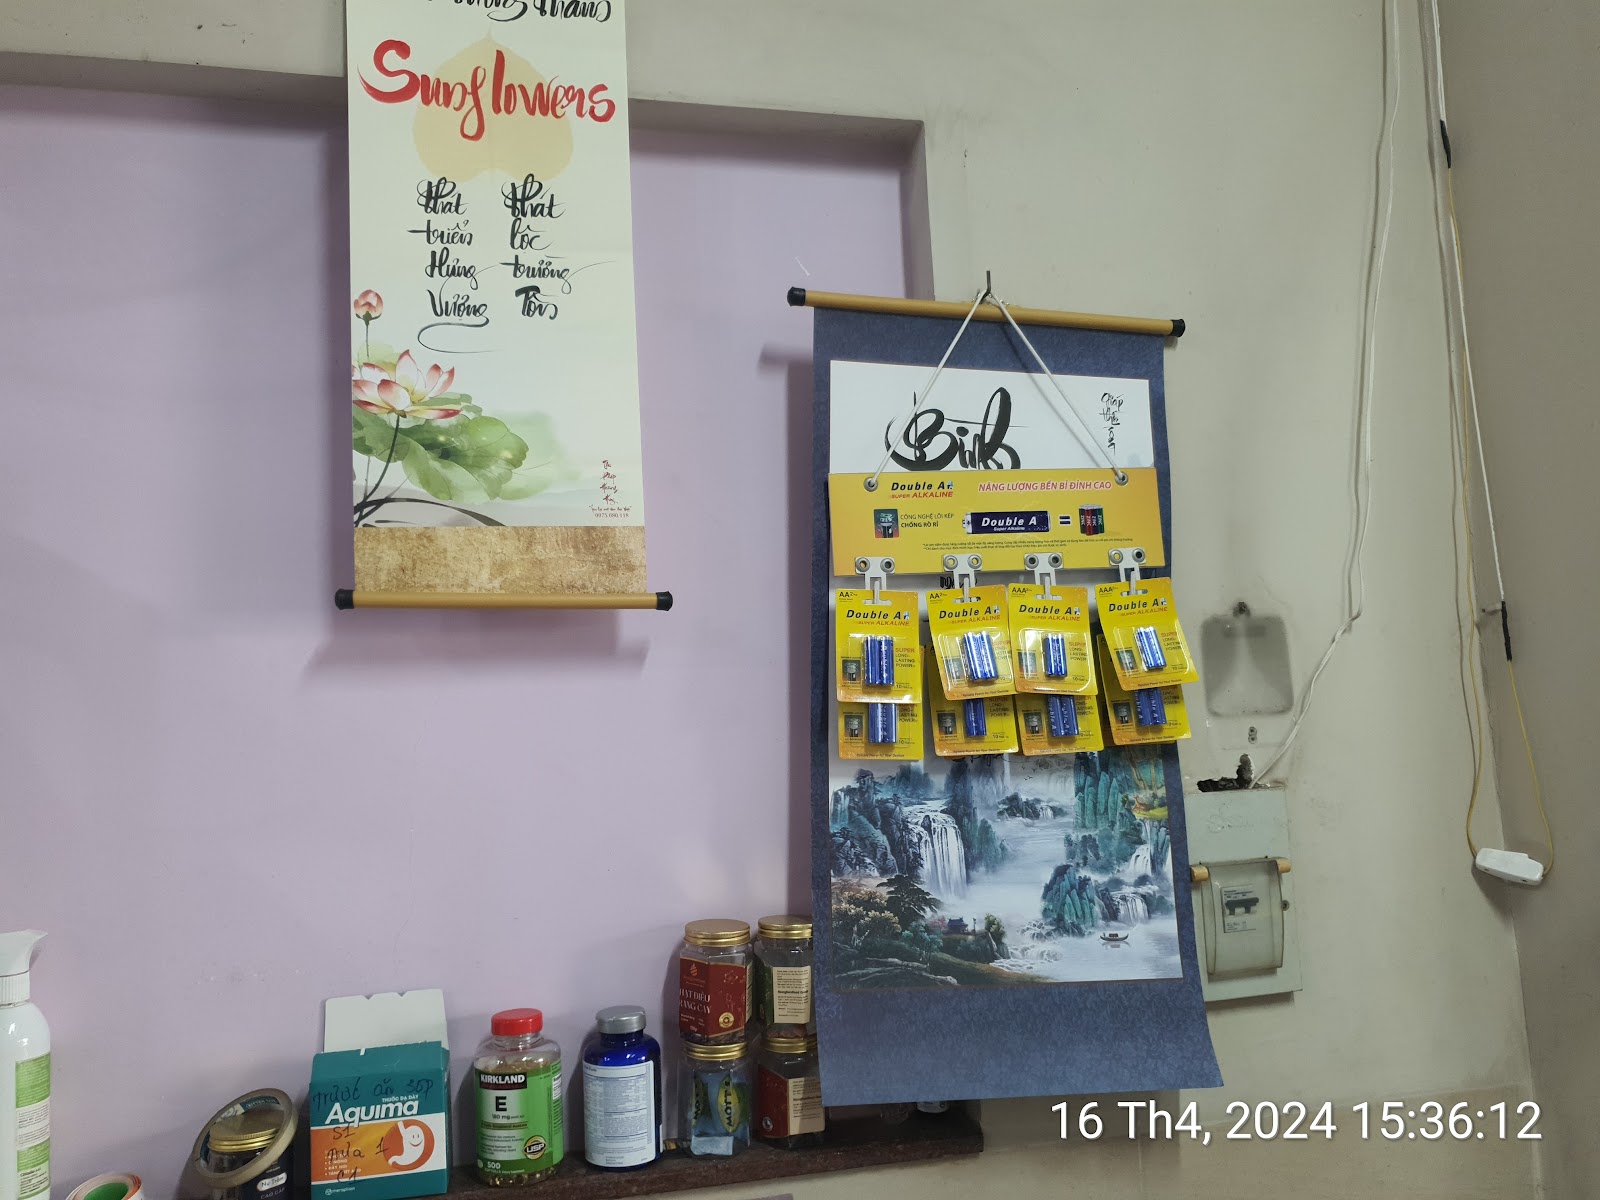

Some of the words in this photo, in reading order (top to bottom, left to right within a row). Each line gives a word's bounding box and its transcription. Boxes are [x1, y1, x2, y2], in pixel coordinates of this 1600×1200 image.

[357, 39, 616, 141] Sunflowers
[891, 482, 933, 491] Double
[938, 482, 945, 490] A
[1007, 481, 1038, 492] LƯỢNG
[981, 517, 1024, 527] Double
[1029, 516, 1037, 526] A
[1019, 605, 1060, 614] Double
[1108, 600, 1147, 612] Double
[846, 610, 889, 619] Double
[939, 608, 979, 619] Double
[985, 607, 991, 615] A
[480, 1074, 525, 1083] KIRKLAND
[496, 1096, 507, 1111] E
[324, 1100, 419, 1128] Aquima
[526, 1143, 545, 1152] USP
